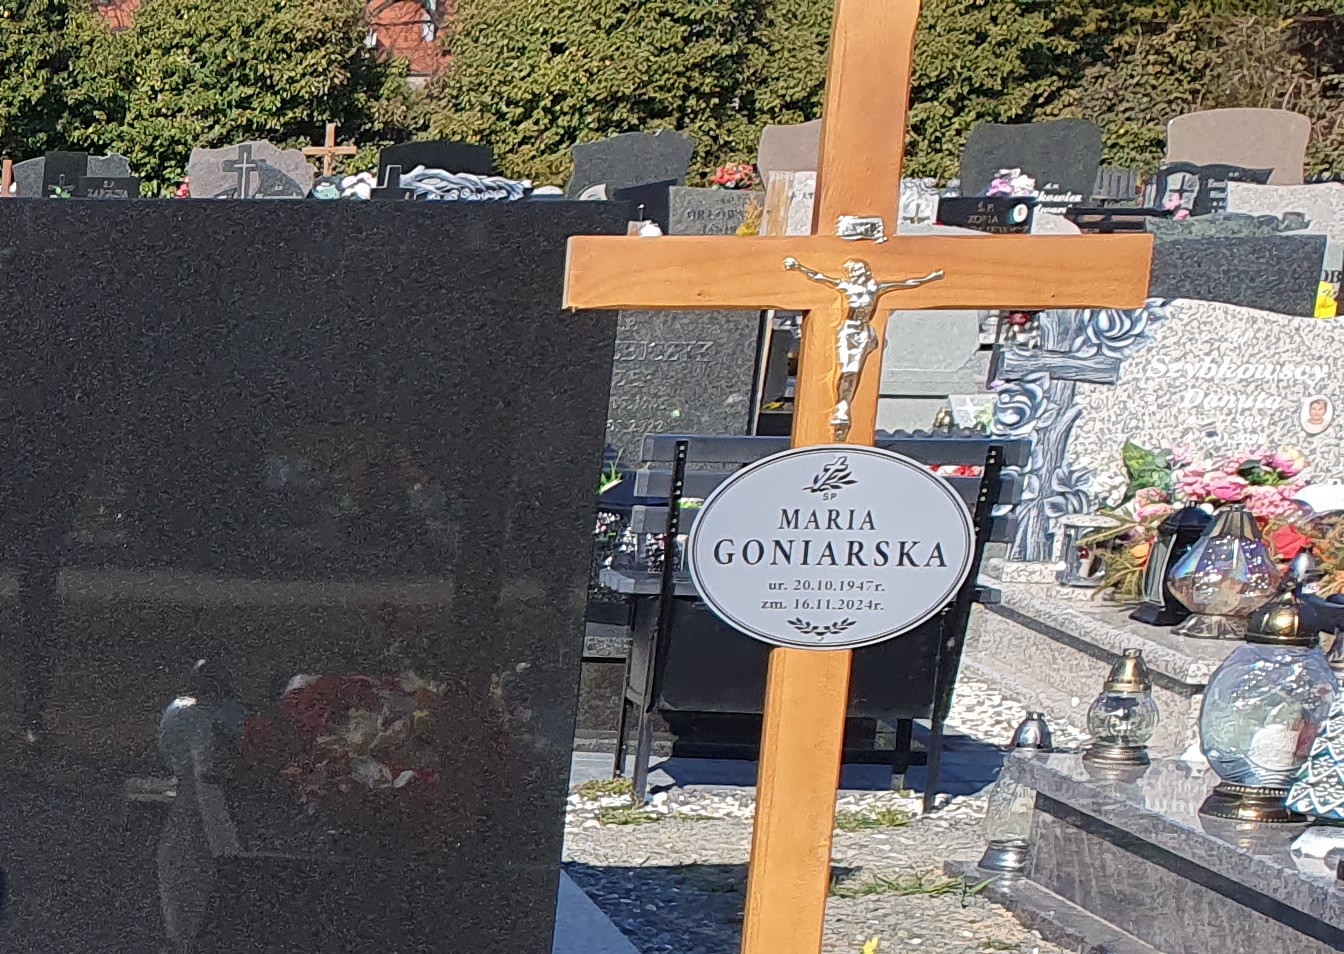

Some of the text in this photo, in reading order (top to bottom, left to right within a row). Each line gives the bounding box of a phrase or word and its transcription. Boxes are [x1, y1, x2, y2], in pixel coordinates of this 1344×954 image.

[777, 508, 877, 531] MARIA
[713, 538, 948, 568] GONIARSKA
[768, 579, 886, 593] ur. 20.10.1947r.
[760, 598, 885, 611] zm. 16.11.2024r.
